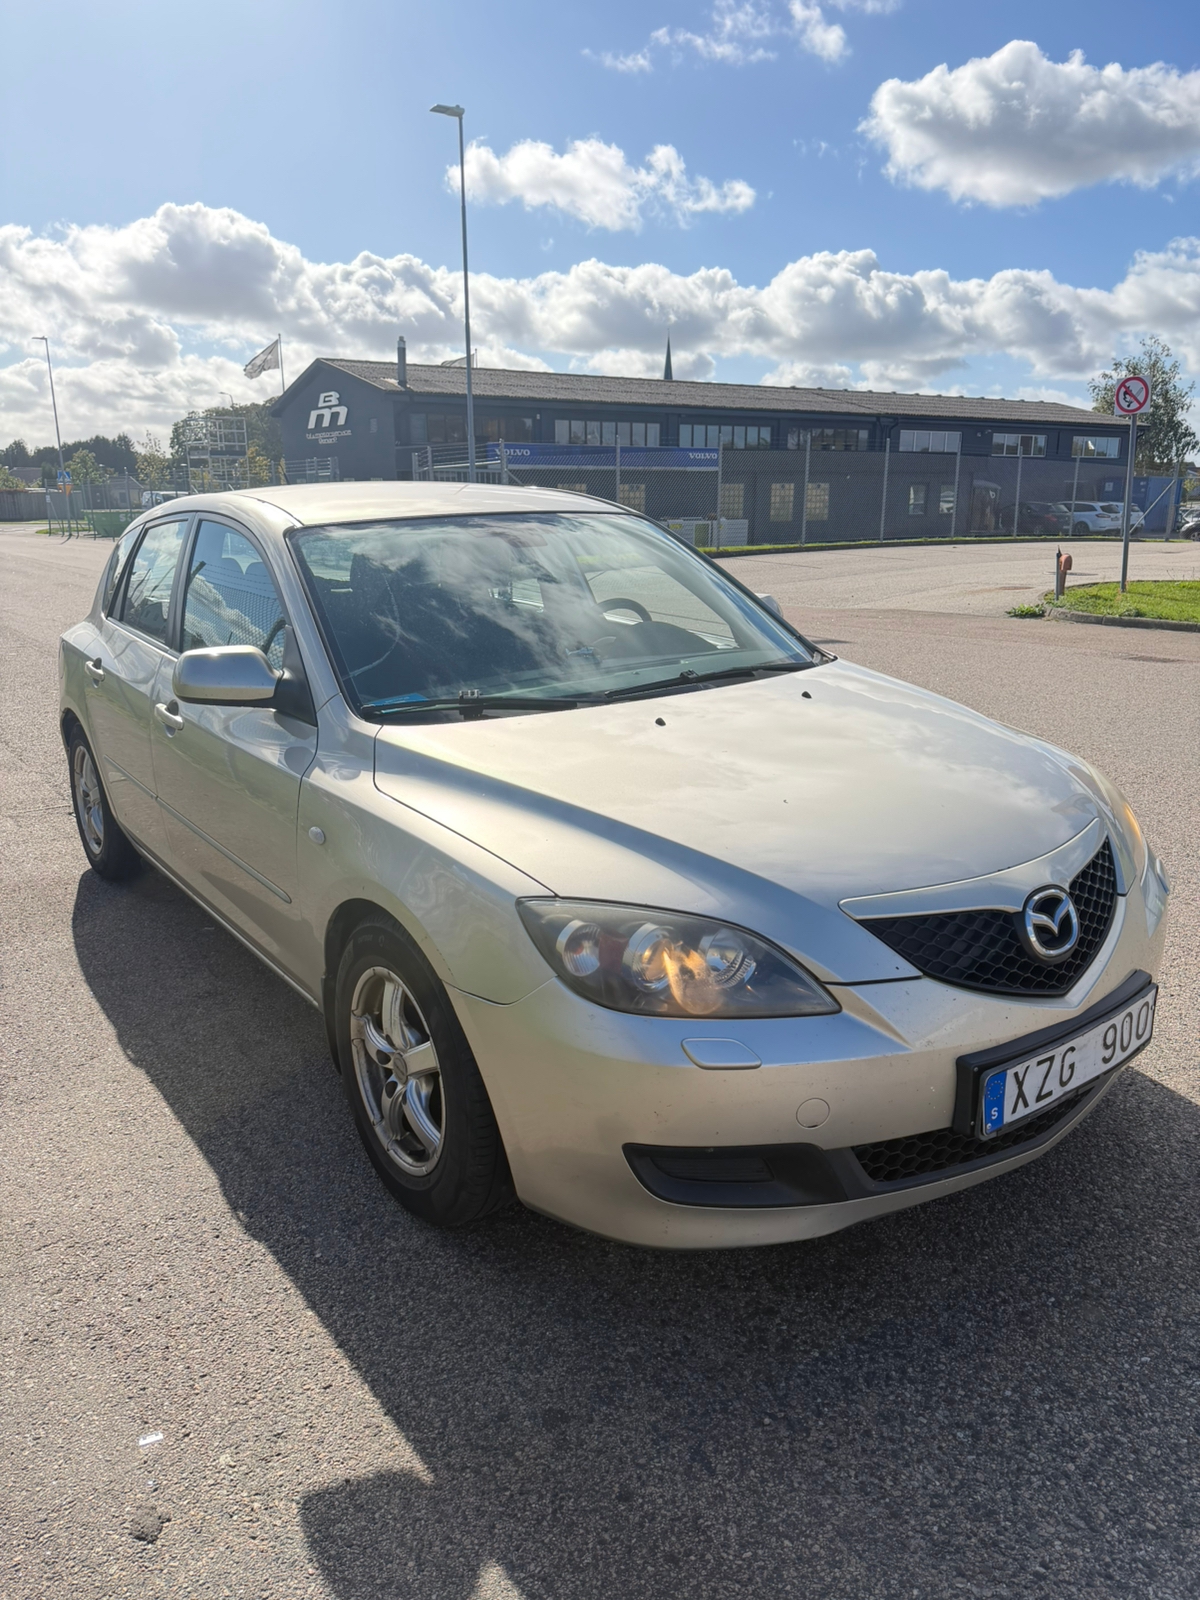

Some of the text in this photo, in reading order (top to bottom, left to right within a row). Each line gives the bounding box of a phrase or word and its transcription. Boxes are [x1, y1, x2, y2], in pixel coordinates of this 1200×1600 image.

[318, 391, 340, 408] B
[494, 448, 531, 456] VOLVO
[689, 452, 718, 460] VOLVO
[1011, 1000, 1151, 1116] XZG 900
[990, 1106, 999, 1120] S
